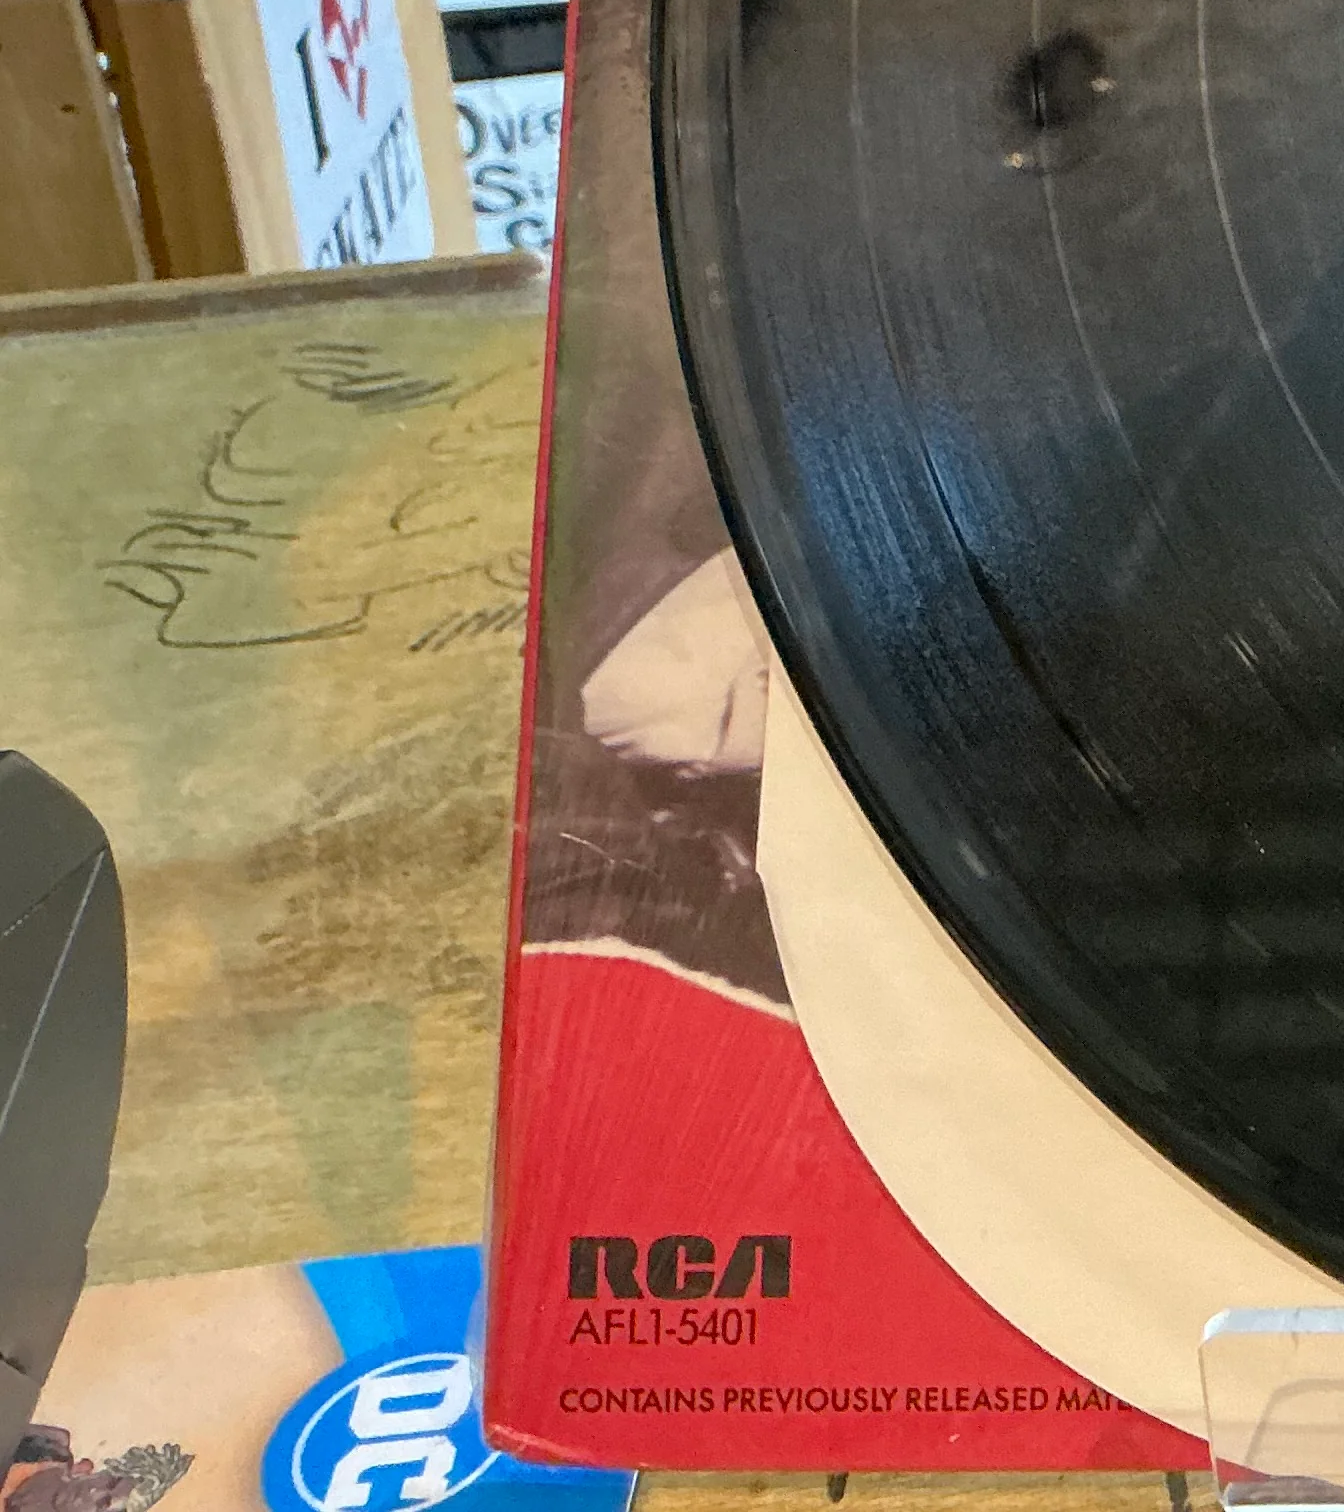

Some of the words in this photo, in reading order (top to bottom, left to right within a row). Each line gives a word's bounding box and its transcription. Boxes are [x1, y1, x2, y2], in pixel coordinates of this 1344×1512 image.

[567, 1234, 793, 1300] RCA
[569, 1307, 758, 1346] AFL1-5401
[558, 1386, 716, 1414] CONTAINS
[723, 1386, 899, 1414] PREVIOUSLY
[905, 1386, 1049, 1414] RELEASED
